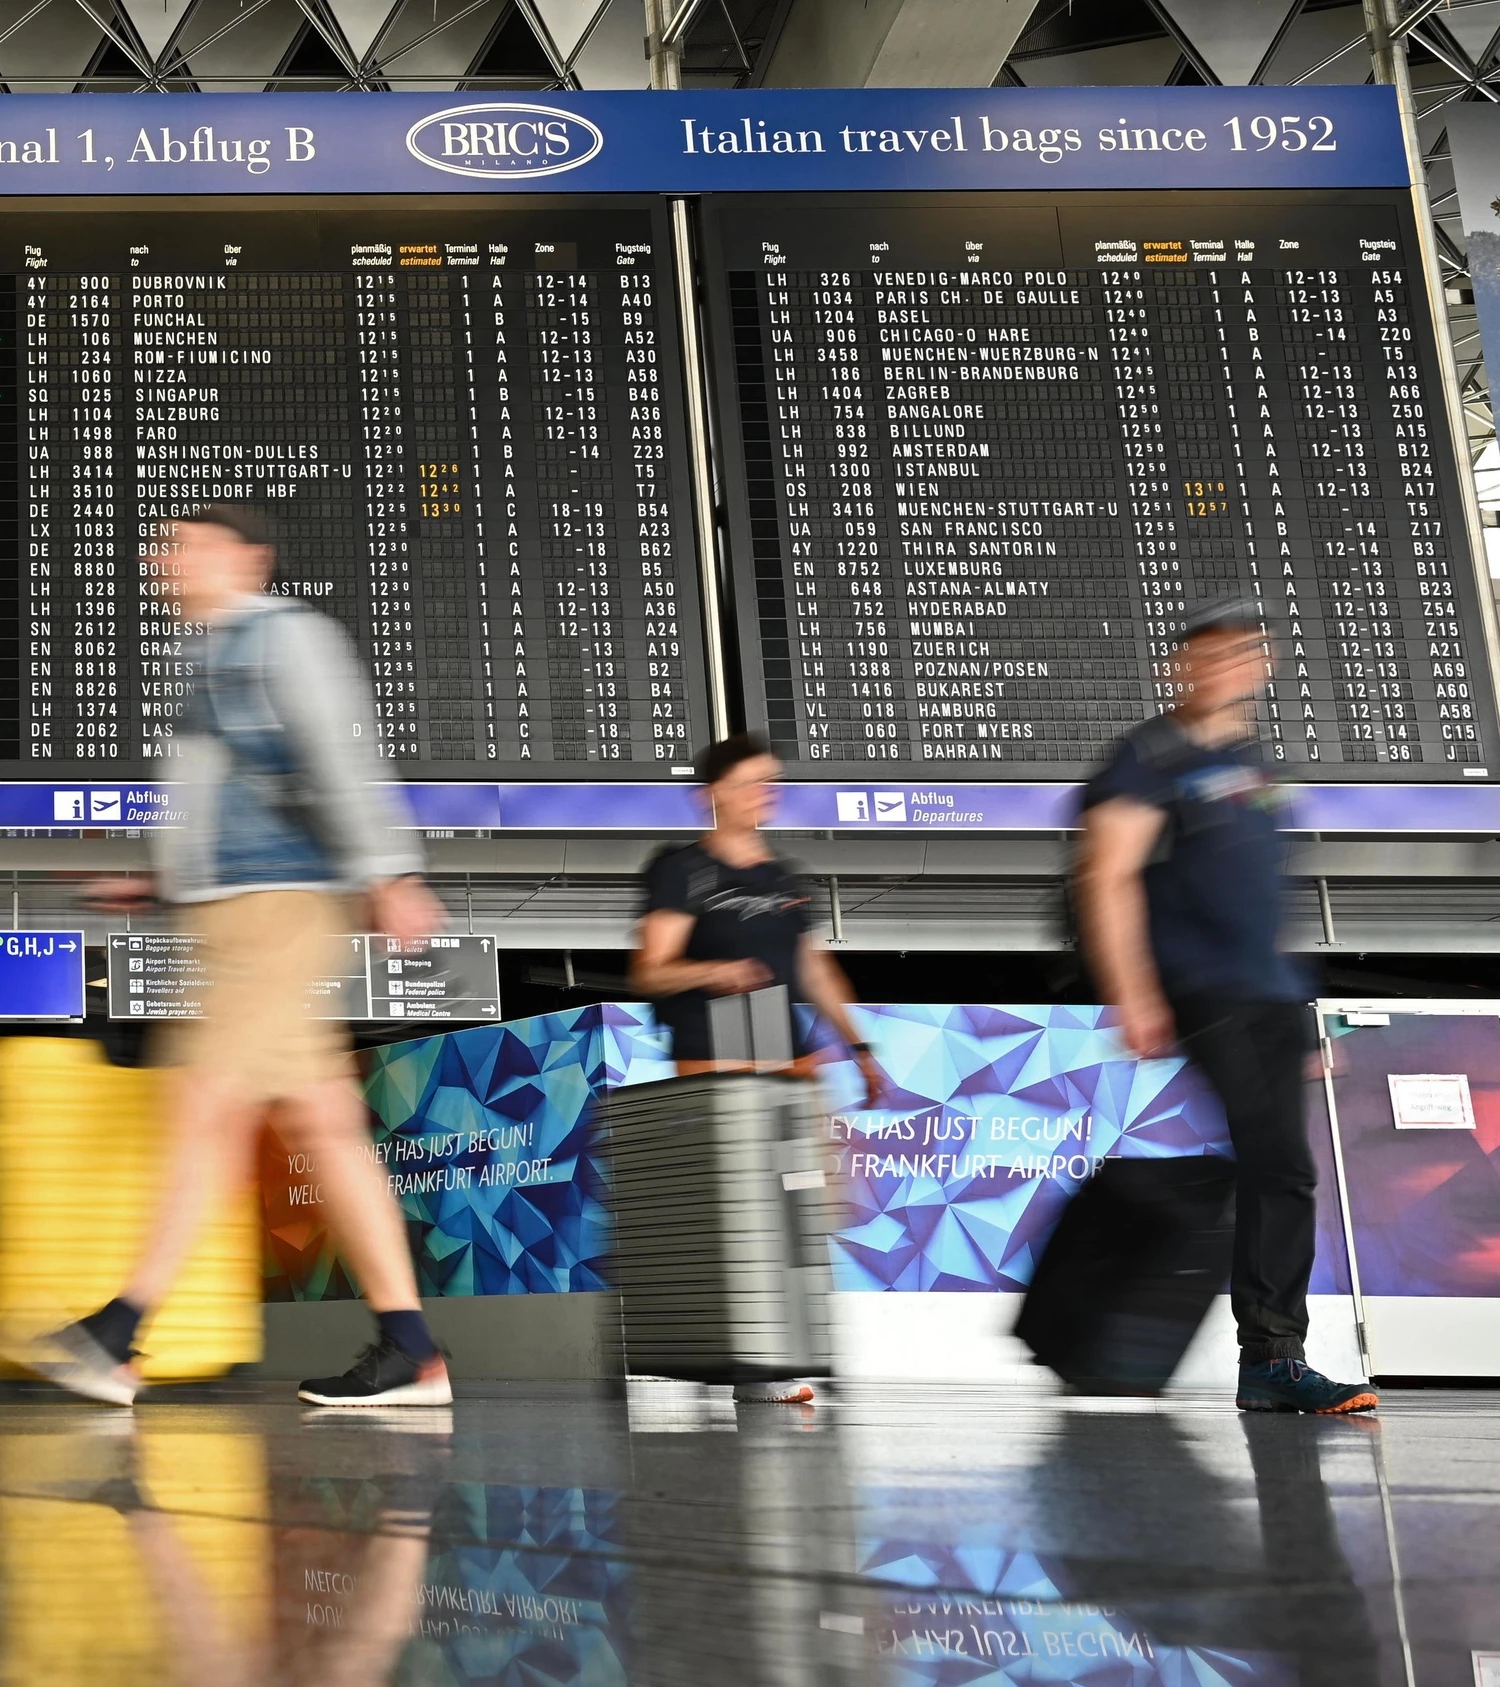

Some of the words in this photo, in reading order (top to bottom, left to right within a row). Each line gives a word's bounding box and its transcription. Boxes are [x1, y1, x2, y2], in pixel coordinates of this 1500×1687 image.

[440, 122, 569, 155] BRIC'S
[681, 118, 825, 153] Italian
[839, 116, 966, 152] travel
[979, 116, 1081, 163] bags
[1099, 118, 1206, 151] since
[1224, 116, 1336, 151] 1952
[78, 129, 113, 171] 1,
[127, 127, 270, 174] Abflug
[285, 128, 315, 161] B
[768, 274, 786, 286] LH
[821, 273, 850, 286] 326
[874, 272, 1012, 285] VENEDIG-MARCO
[1025, 272, 1066, 285] POLO
[1372, 271, 1401, 284] A54
[29, 352, 46, 364] LH
[82, 351, 110, 364] 234
[135, 351, 270, 364] ROM-FIUMICINO
[627, 350, 655, 363] A30
[30, 446, 49, 459] UA
[84, 446, 112, 459] 988
[137, 446, 317, 459] WASHINGTON-DULLES
[634, 445, 663, 458] Z23
[796, 582, 815, 595] LH
[852, 582, 881, 595] 648
[907, 582, 1048, 595] ASTANA-ALMATY
[1420, 582, 1451, 595] B23
[31, 642, 50, 655] EN
[75, 642, 115, 655] 8062
[141, 642, 182, 655] GRAZ
[648, 643, 678, 656] A19
[810, 724, 828, 737] 4Y
[866, 724, 896, 737] 060
[923, 724, 964, 737] FORT
[978, 724, 1032, 737] MYERS
[1443, 725, 1474, 739] C15
[127, 791, 168, 806] Abflug
[911, 792, 953, 809] Abflug
[913, 808, 986, 826] Departures
[865, 1117, 917, 1141] HAS
[923, 1117, 983, 1145] JUST
[991, 1117, 1092, 1141] BEGUN!
[288, 1153, 320, 1175] YOU
[396, 1137, 424, 1162] HAS
[428, 1133, 464, 1162] JUST
[468, 1123, 533, 1153] BEGUN!
[851, 1153, 1002, 1178] FRANKFURT
[288, 1182, 327, 1206] WELC
[387, 1167, 475, 1197] FRANKFURT
[478, 1158, 554, 1187] AIRPORT.
